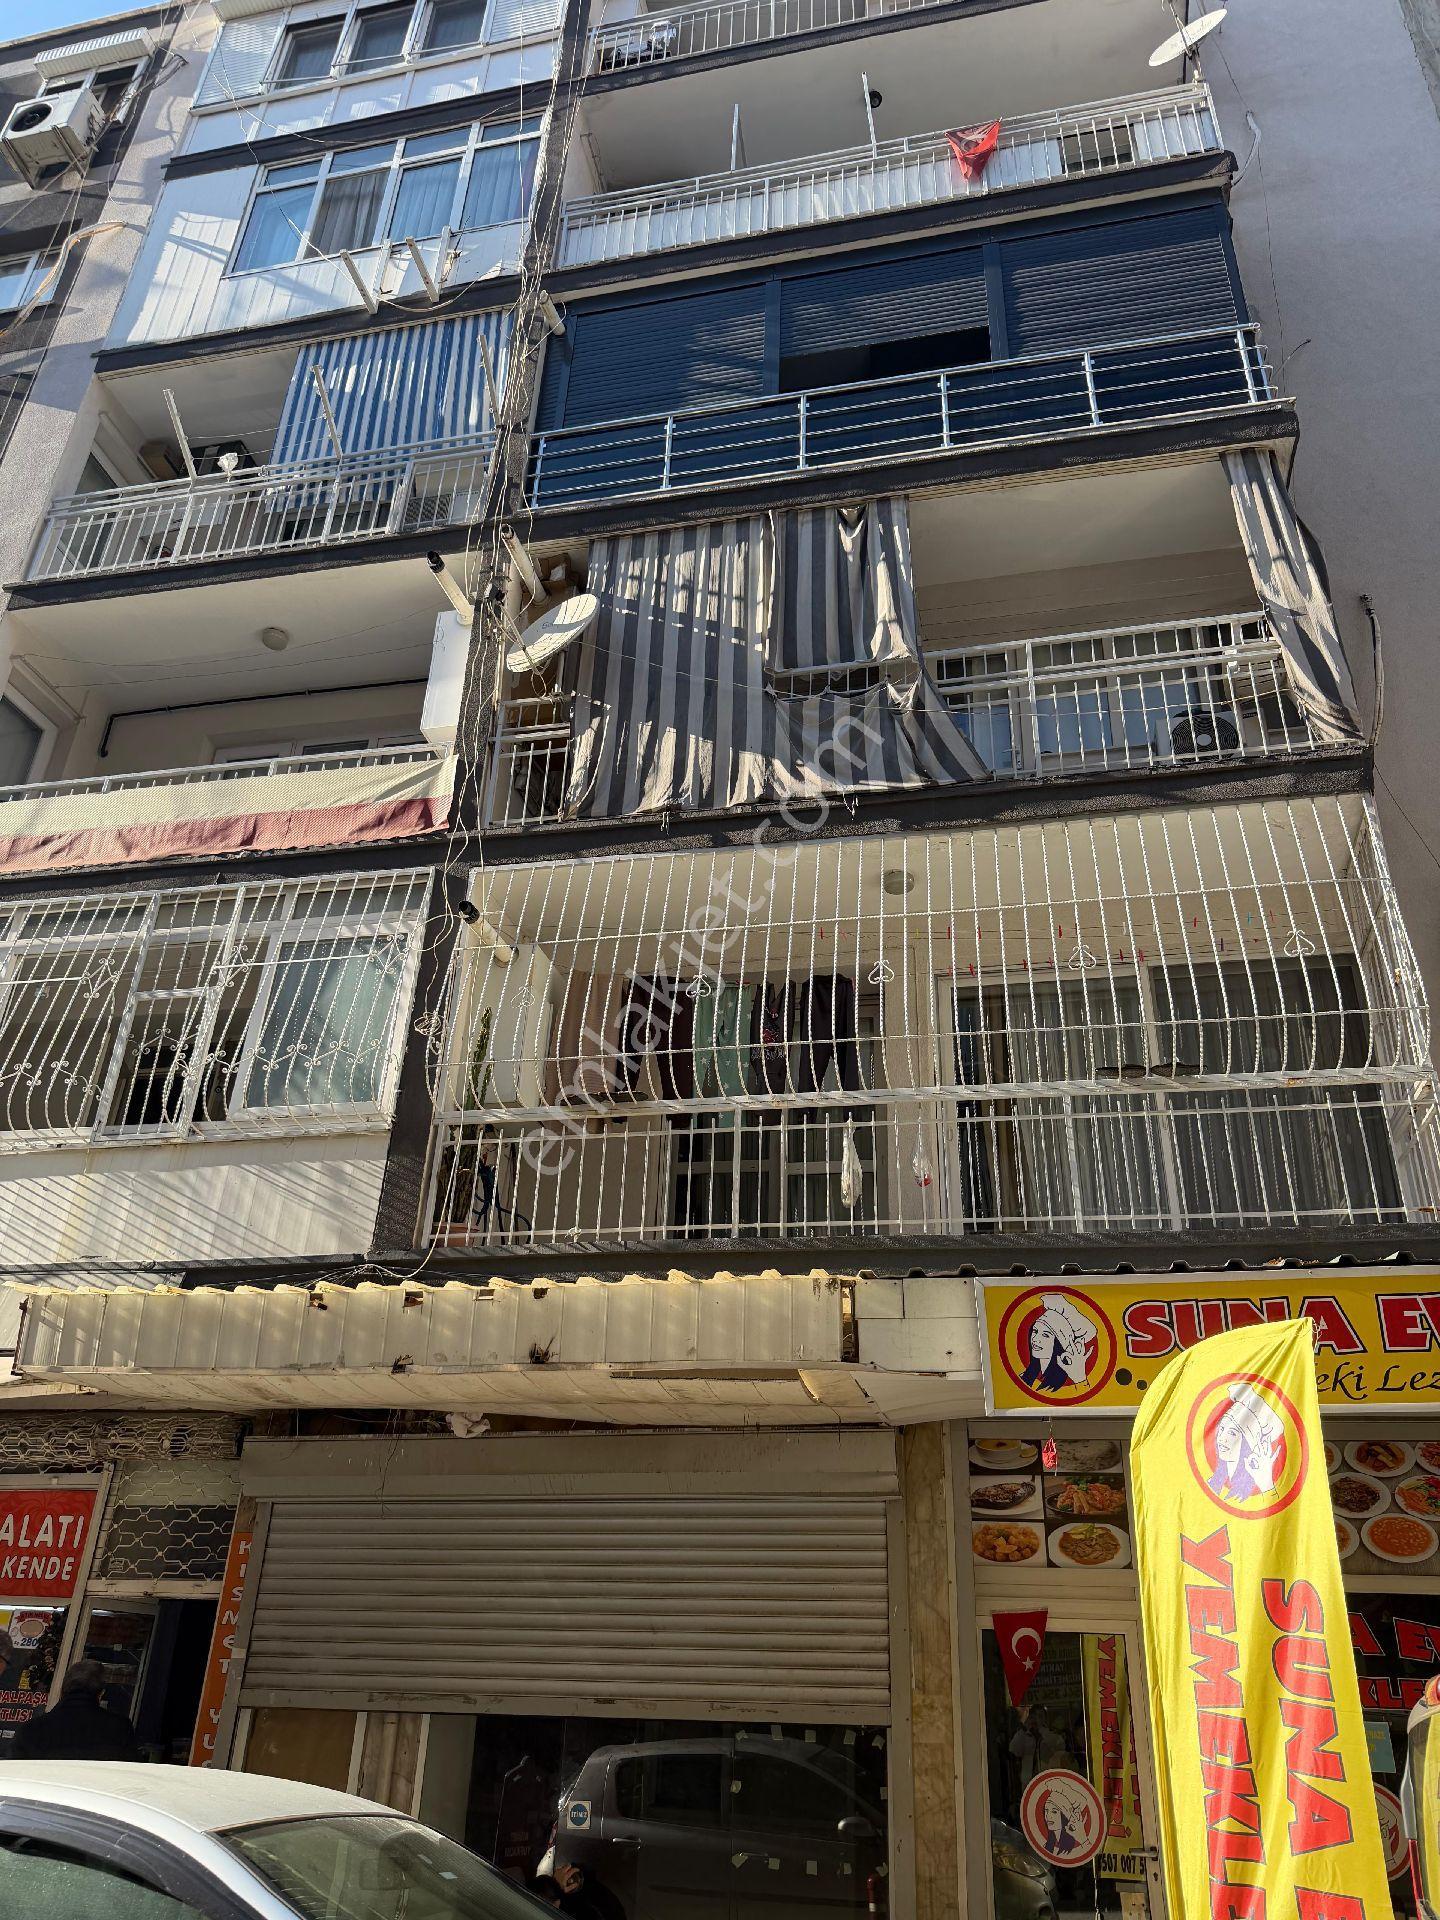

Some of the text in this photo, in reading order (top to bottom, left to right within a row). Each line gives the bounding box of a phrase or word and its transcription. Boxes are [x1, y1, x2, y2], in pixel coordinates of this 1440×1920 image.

[1314, 1361, 1368, 1401] eki
[0, 1513, 84, 1549] ALATI
[0, 1555, 75, 1580] KENDE
[1261, 1578, 1354, 1856] SUNA
